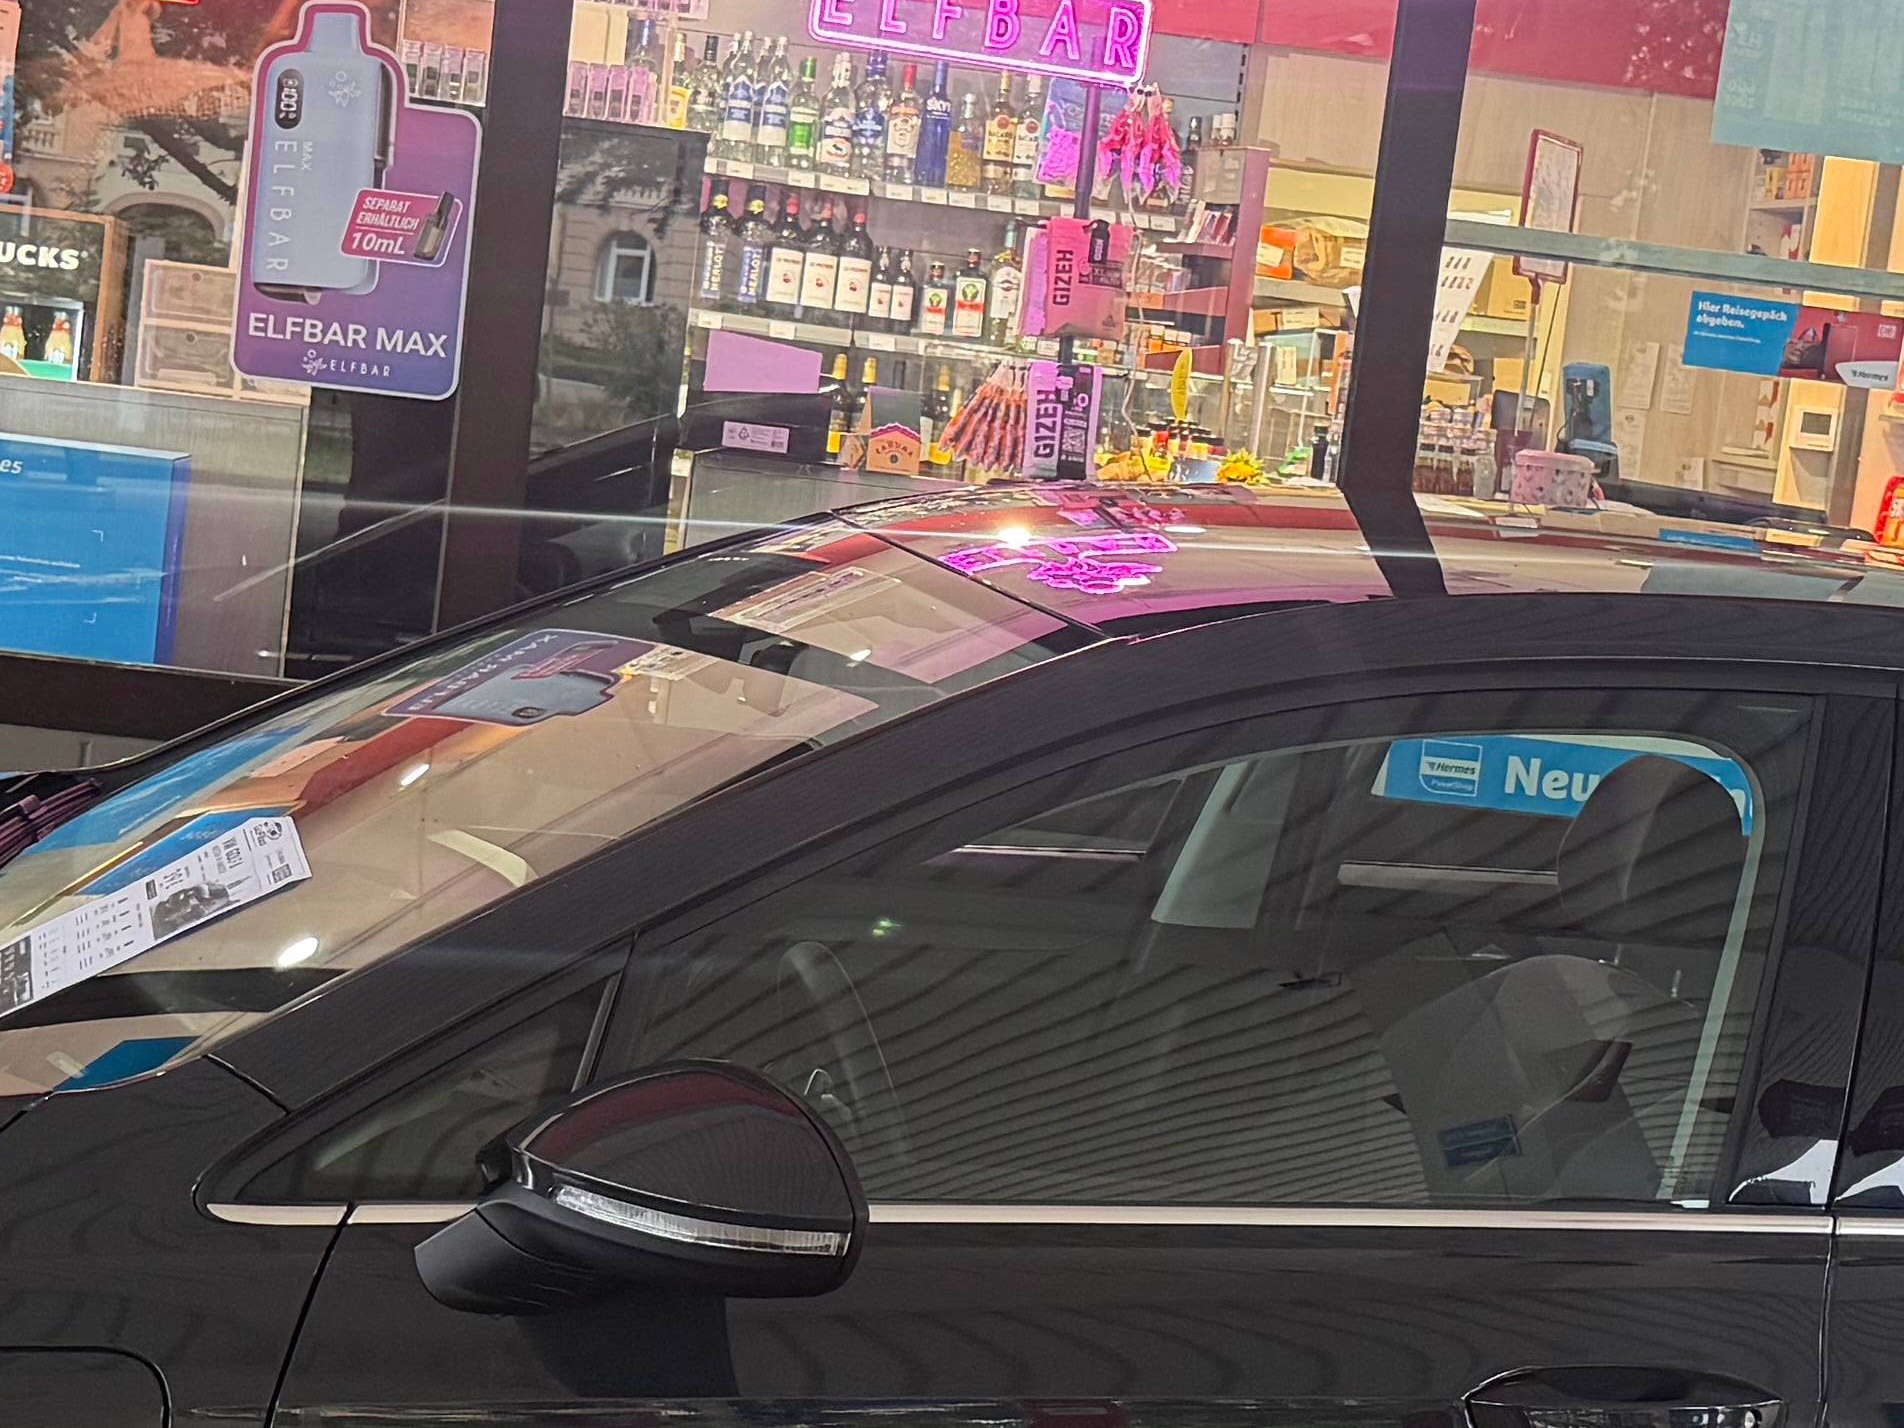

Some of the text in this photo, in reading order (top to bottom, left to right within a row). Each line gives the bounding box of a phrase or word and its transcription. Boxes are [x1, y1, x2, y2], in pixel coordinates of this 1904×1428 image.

[300, 141, 313, 171] MAX
[265, 140, 297, 271] ELFBAR
[362, 196, 410, 213] SEPARAT
[356, 210, 420, 231] ERHÄLTLICH
[351, 232, 406, 256] 10mL
[1053, 250, 1074, 306] GIZEH
[1698, 301, 1788, 322] Hier Reisegepäck
[248, 312, 448, 359] ELFBAR MAX
[330, 359, 391, 378] ELFBAR
[1034, 390, 1058, 459] GIZEH
[1436, 760, 1477, 776] Hermes
[1504, 755, 1600, 803] Neu
